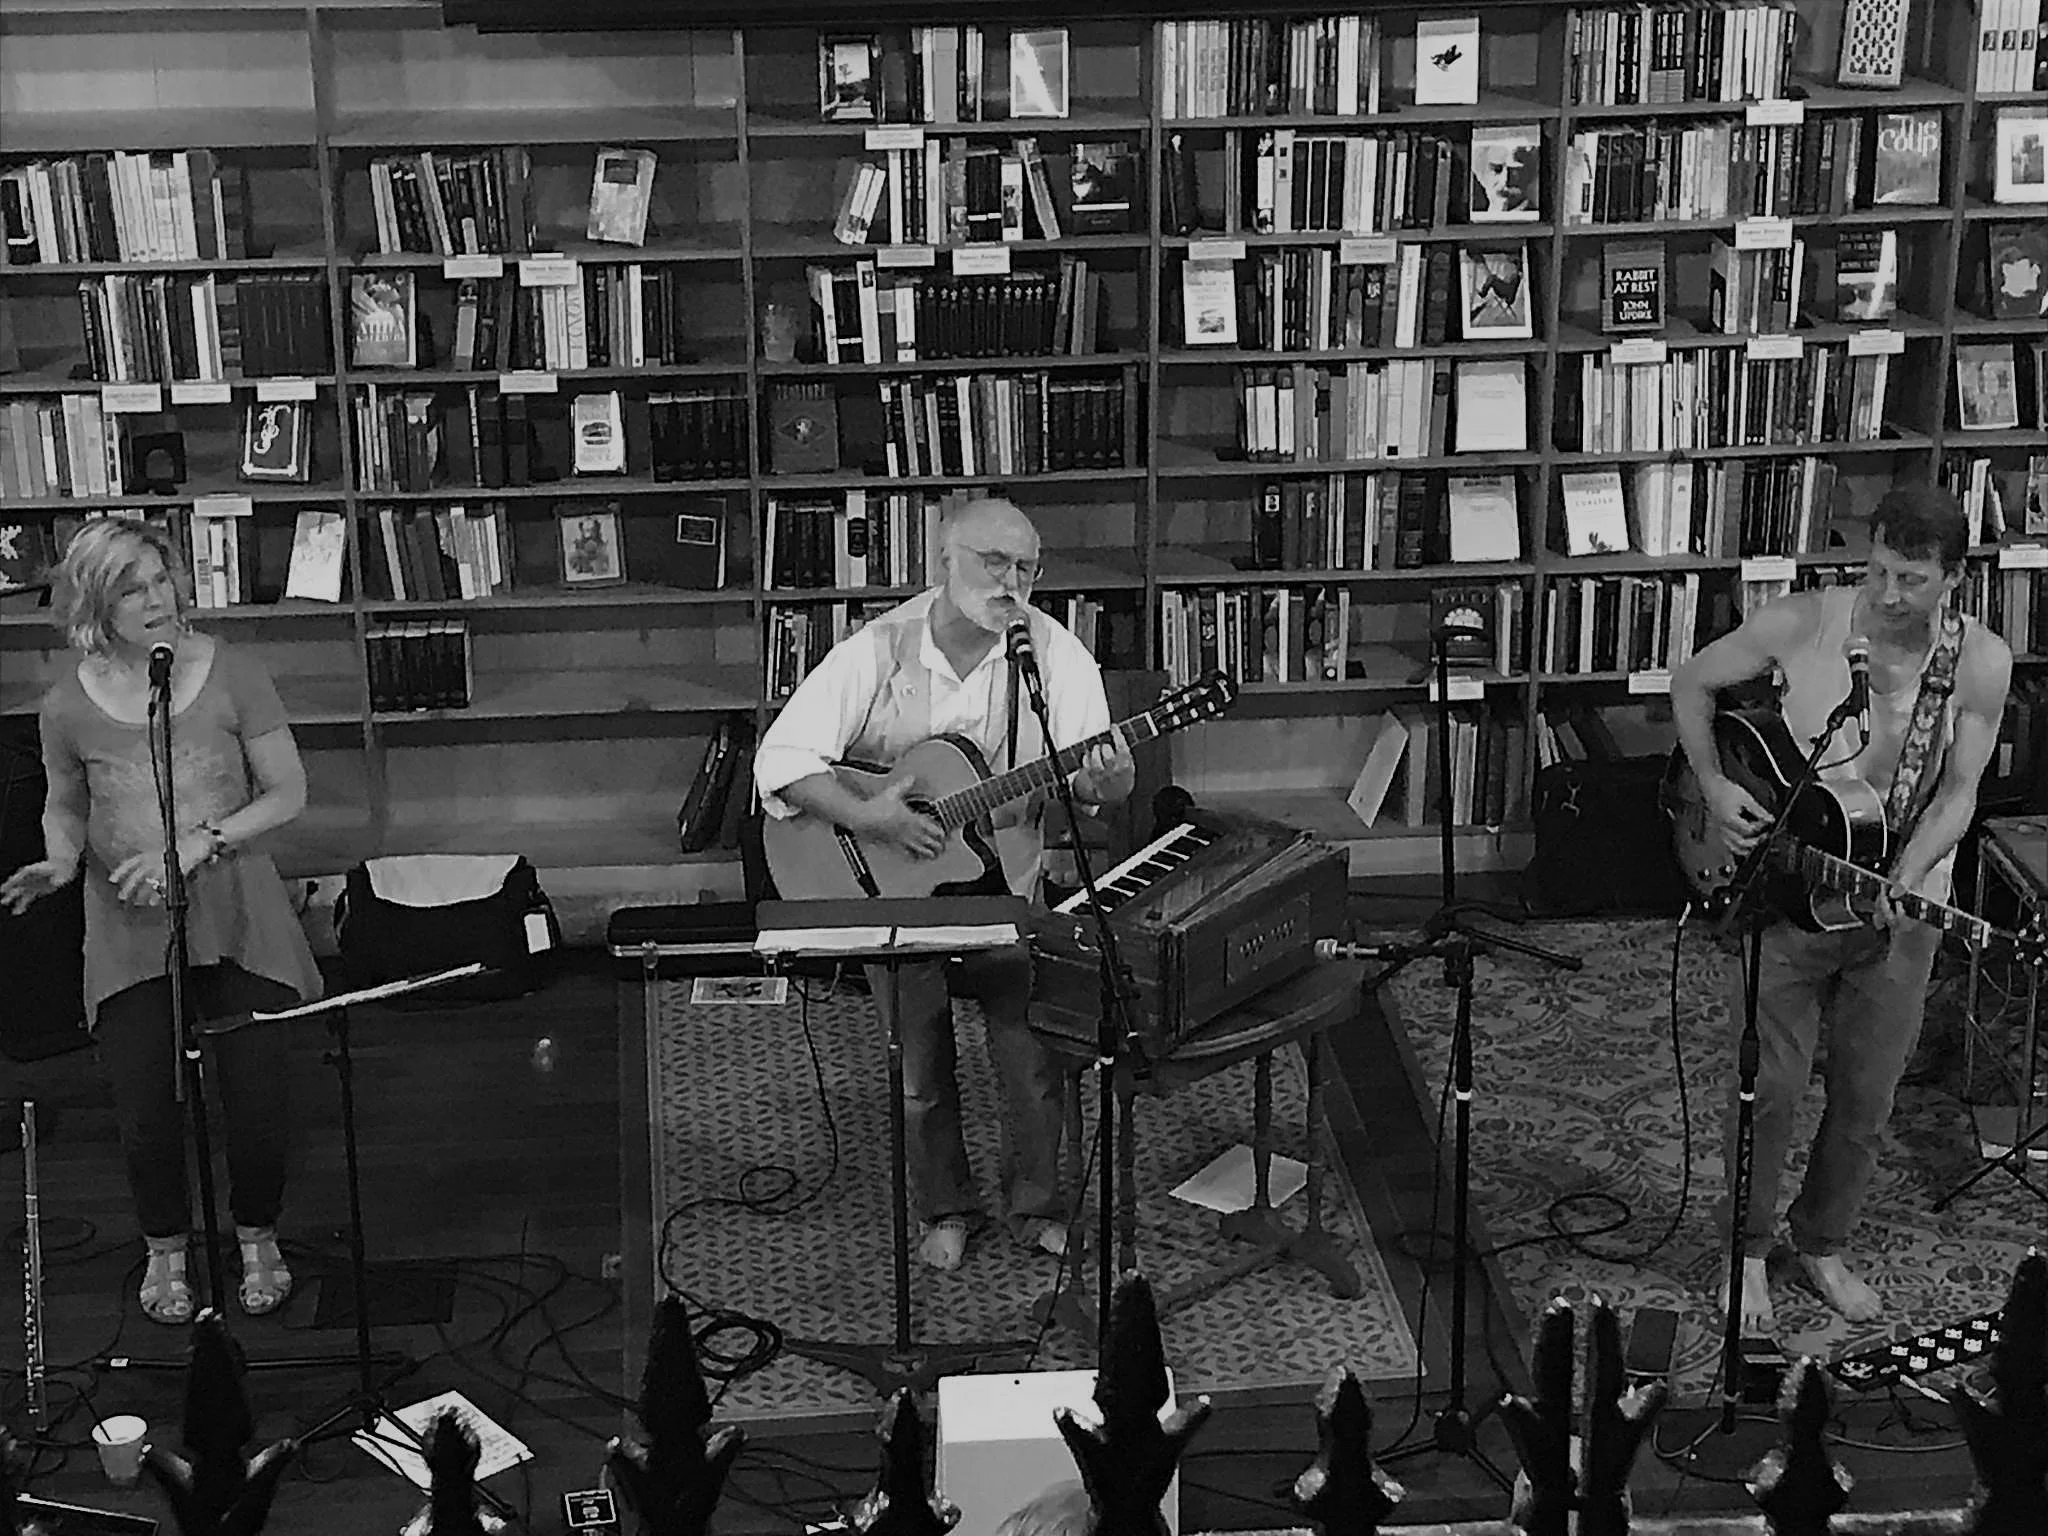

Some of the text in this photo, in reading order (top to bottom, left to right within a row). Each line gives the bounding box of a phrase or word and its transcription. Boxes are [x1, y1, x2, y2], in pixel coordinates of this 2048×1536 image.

[1615, 269, 1656, 281] RABBIT
[1613, 281, 1657, 294] AT REST
